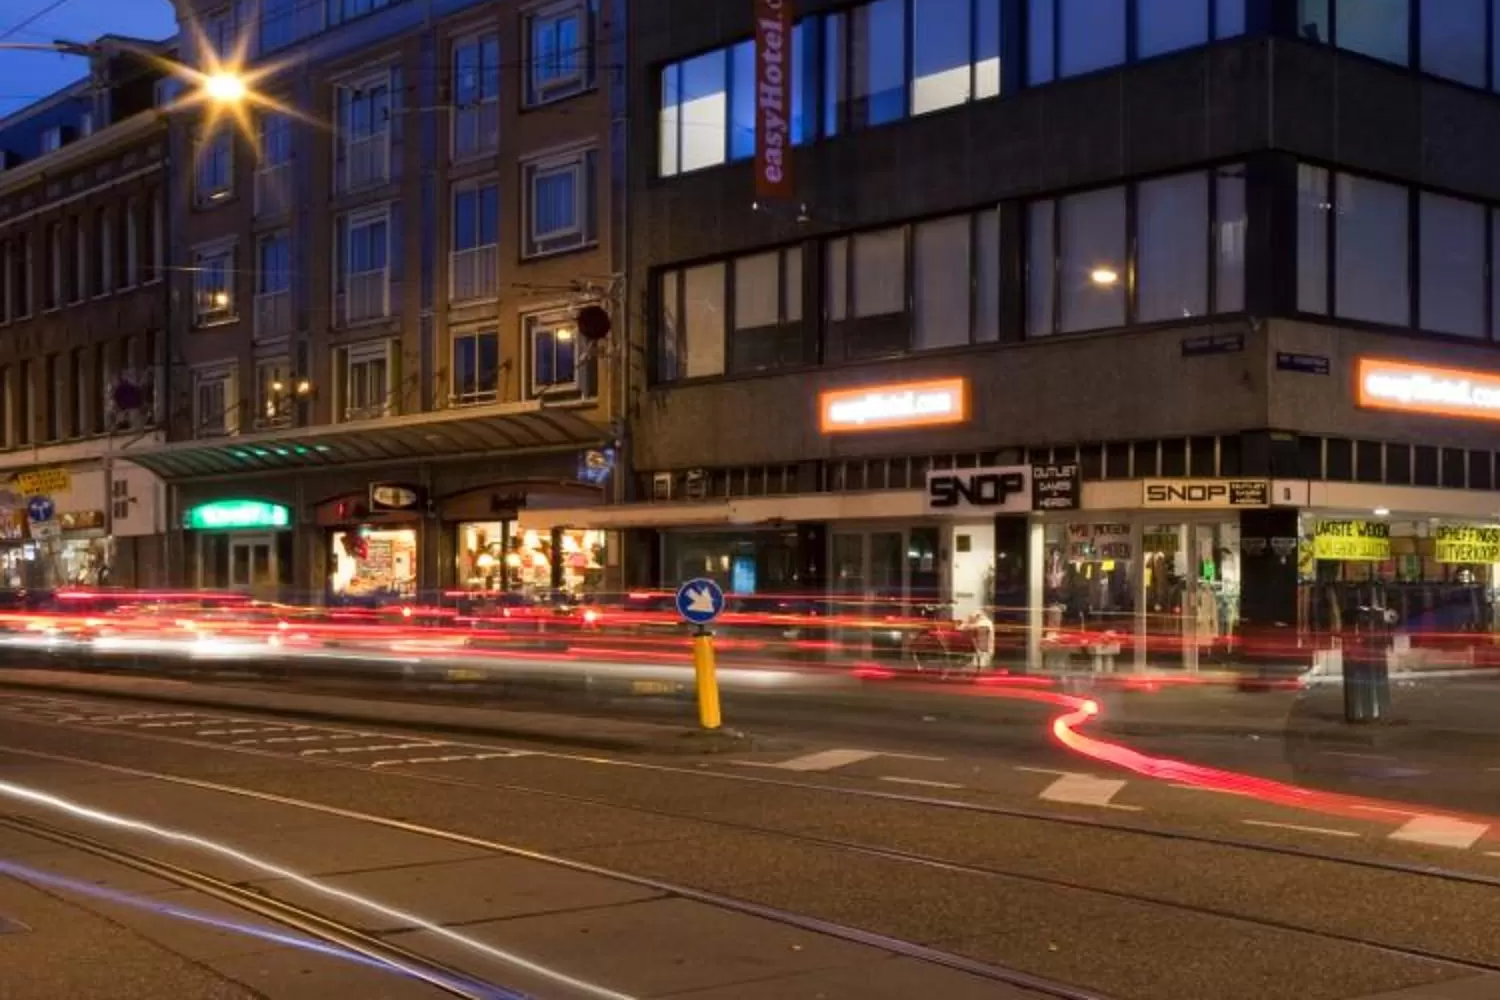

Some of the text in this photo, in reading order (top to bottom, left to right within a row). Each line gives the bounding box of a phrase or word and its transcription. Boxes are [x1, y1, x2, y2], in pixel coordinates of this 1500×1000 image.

[1033, 465, 1077, 479] OUTLET
[930, 472, 1023, 508] SNOP
[1147, 484, 1227, 501] SNOP
